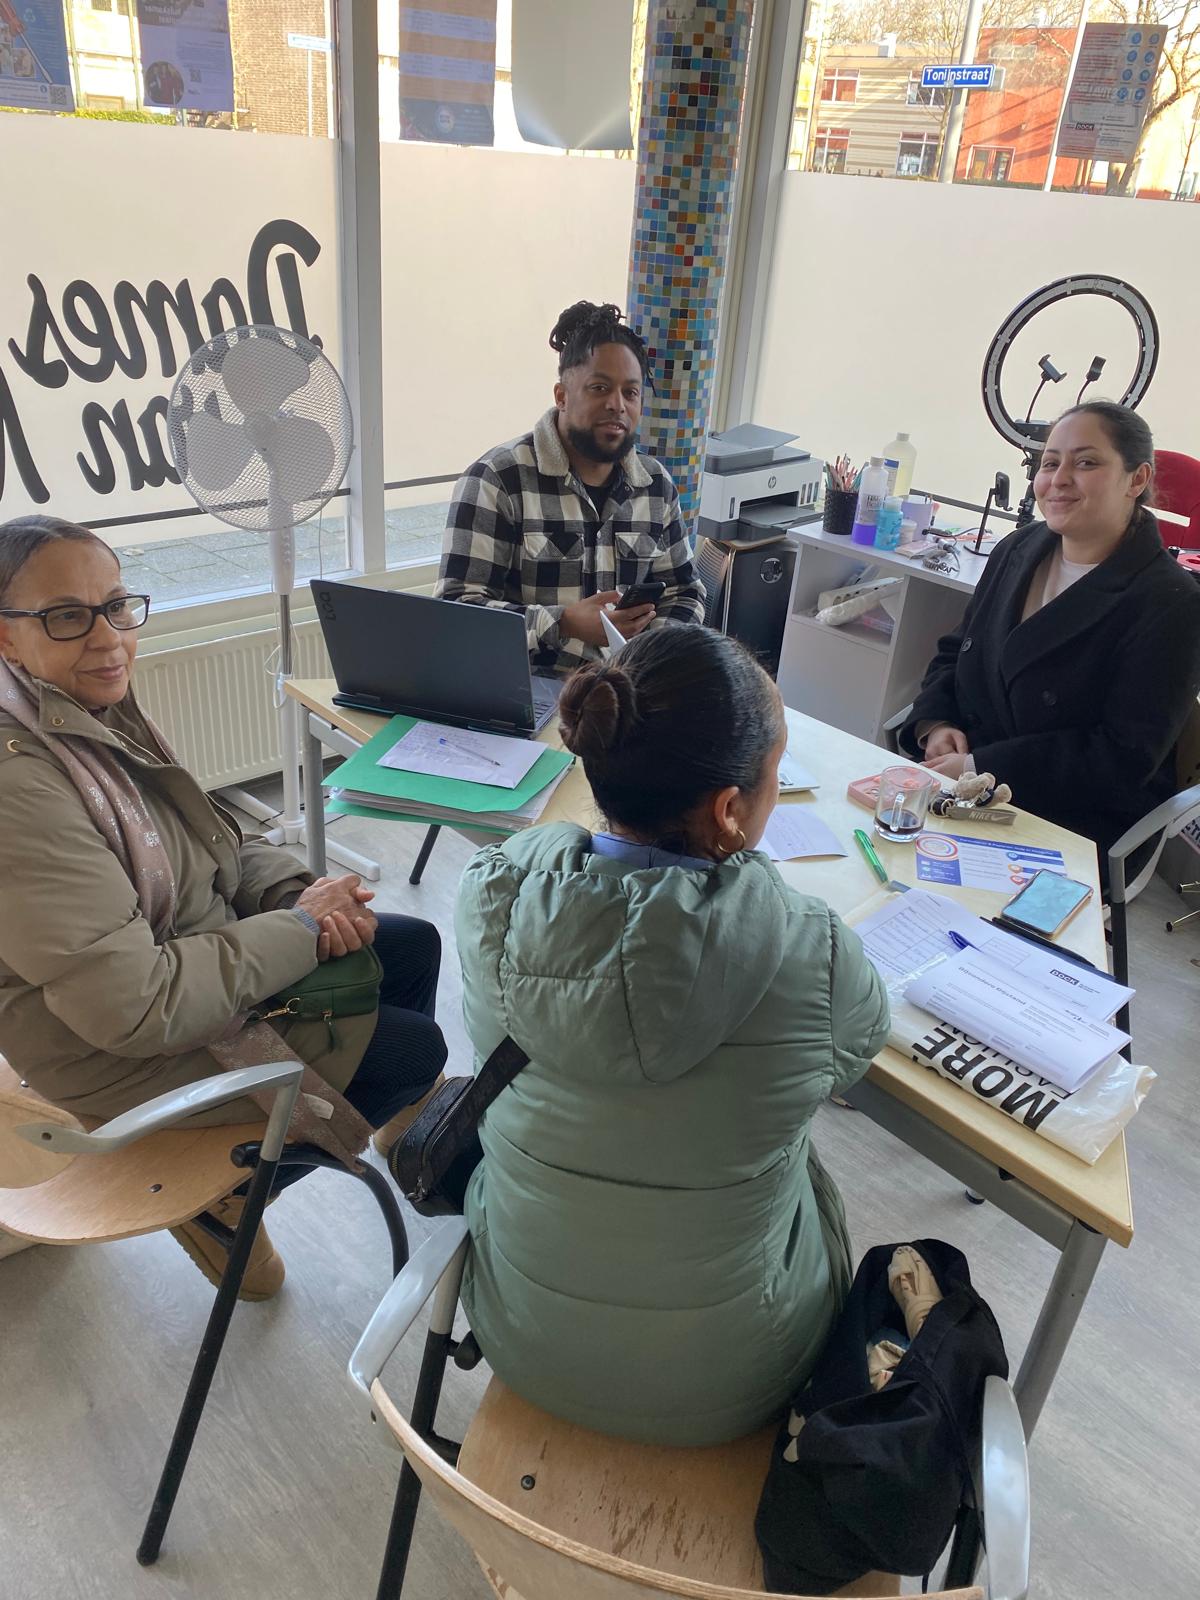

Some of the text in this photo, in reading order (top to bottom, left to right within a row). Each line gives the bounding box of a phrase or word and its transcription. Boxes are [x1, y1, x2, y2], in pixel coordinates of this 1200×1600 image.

[926, 67, 989, 81] Tonijnstraat
[968, 810, 993, 823] NIKE
[1051, 970, 1078, 986] DOCK
[912, 1027, 1060, 1131] MORE
